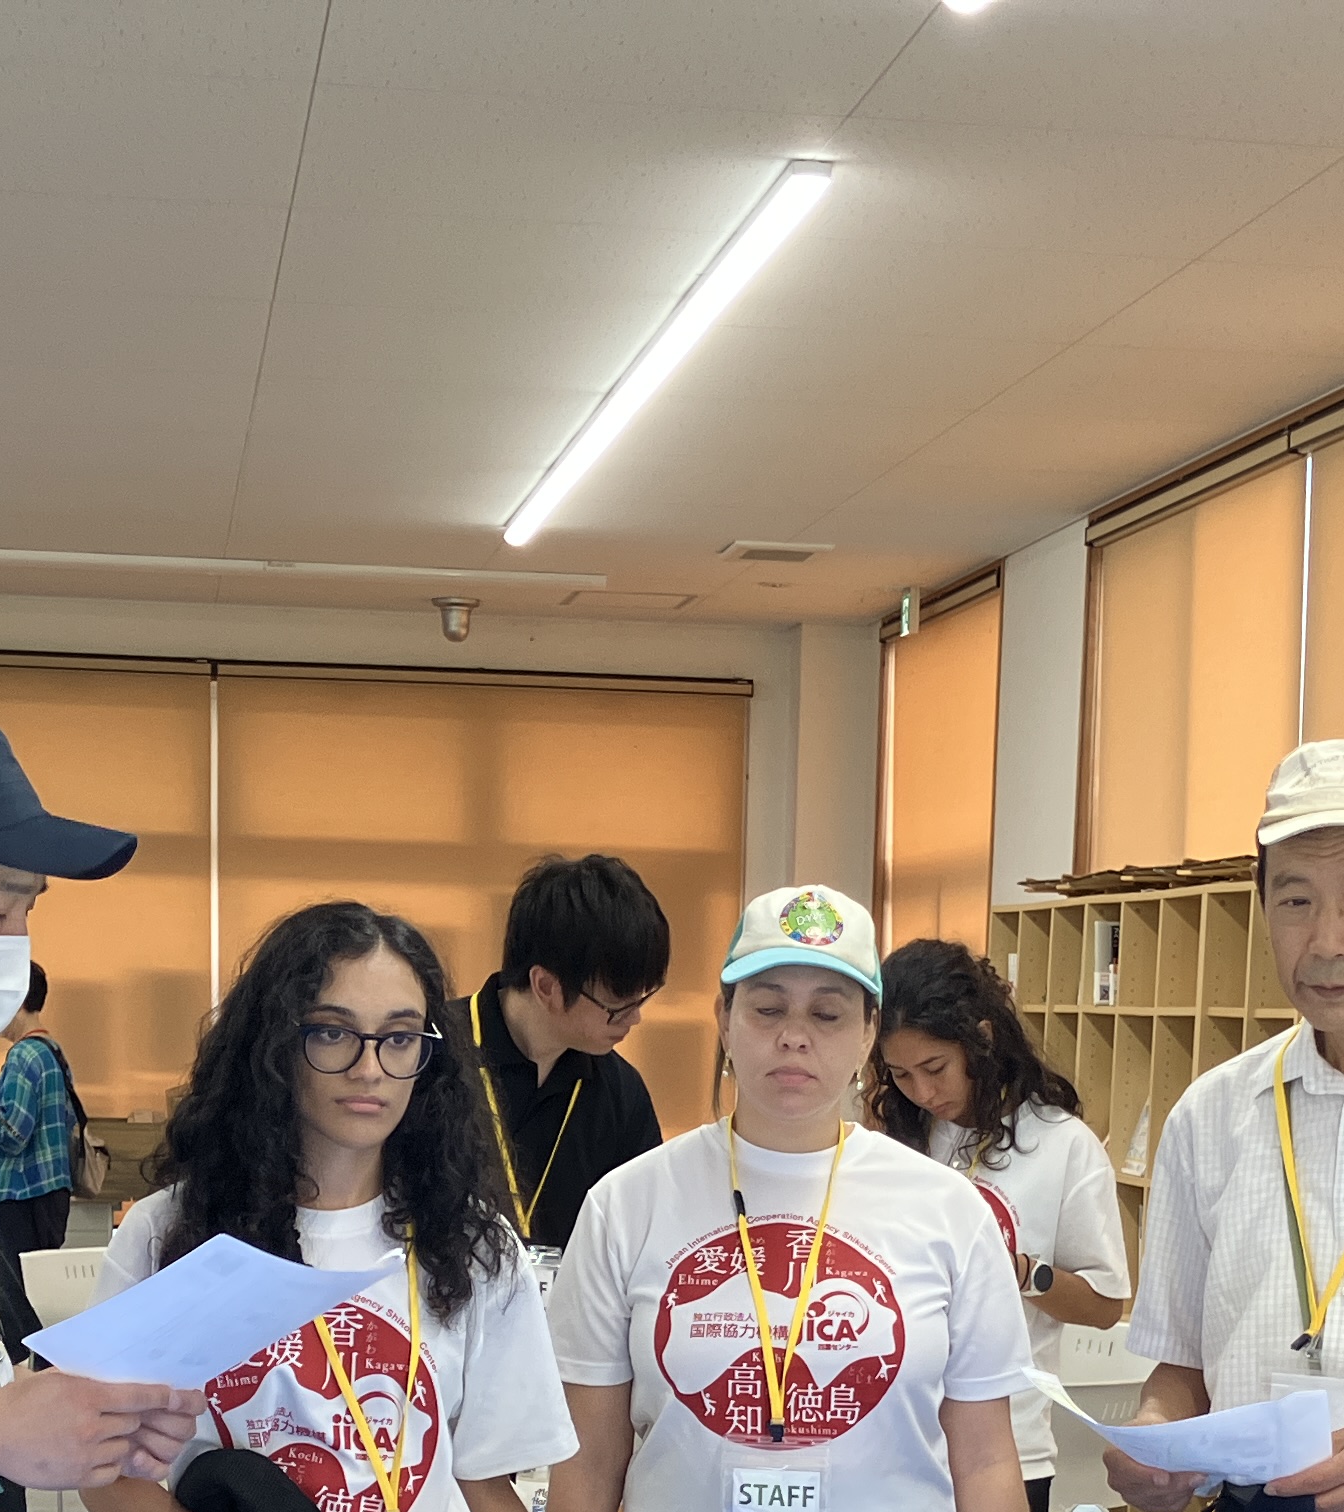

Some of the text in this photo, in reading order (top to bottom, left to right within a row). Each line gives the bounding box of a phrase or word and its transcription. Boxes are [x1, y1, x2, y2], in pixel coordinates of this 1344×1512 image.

[665, 1247, 689, 1270] Japan
[687, 1222, 739, 1249] Internation
[746, 1213, 804, 1224] Cooperation
[806, 1216, 840, 1234] Agncy
[842, 1231, 874, 1256] Shikoku
[874, 1254, 896, 1276] Center
[693, 1245, 766, 1276] 愛媛
[678, 1273, 719, 1286] Ehime
[825, 1266, 868, 1278] Kagawa
[385, 1308, 412, 1335] Shiko
[693, 1312, 755, 1323] 独立行政法人
[827, 1310, 855, 1319] ジャイカ
[365, 1321, 378, 1355] かがわ
[690, 1322, 789, 1341] 国際協力構
[216, 1374, 259, 1389] Ehime
[725, 1363, 763, 1435] 高知
[786, 1383, 862, 1425] 徳島
[783, 1424, 838, 1435] okushima
[288, 1447, 324, 1464] Kochi
[738, 1483, 815, 1508] STAFF
